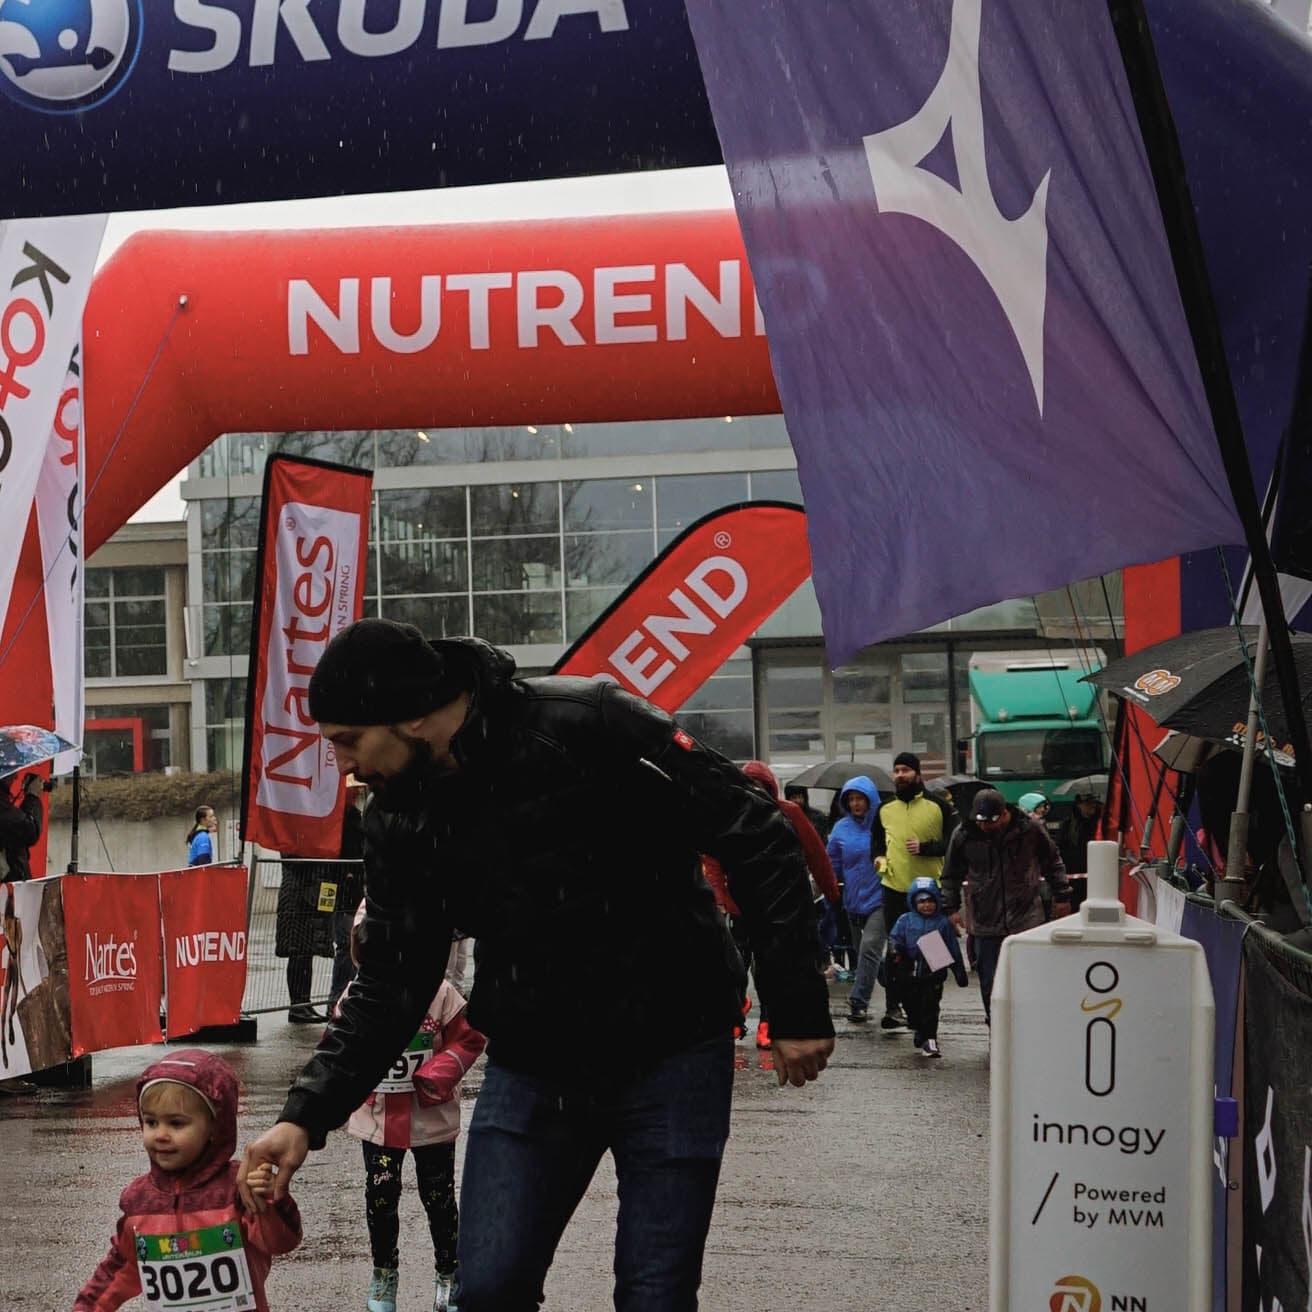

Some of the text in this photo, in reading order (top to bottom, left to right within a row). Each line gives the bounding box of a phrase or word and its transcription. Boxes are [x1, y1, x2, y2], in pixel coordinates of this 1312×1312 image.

[288, 260, 767, 356] NUTREN
[339, 565, 350, 613] SPRING
[589, 556, 748, 697] END
[264, 535, 334, 791] Nartes
[85, 932, 137, 980] Nartes
[176, 931, 246, 968] NUTEND
[1033, 1113, 1166, 1155] innogy
[1073, 1183, 1166, 1204] Powered
[1073, 1206, 1165, 1228] by MVM
[141, 1255, 239, 1301] 3020
[1111, 1295, 1147, 1312] NN
